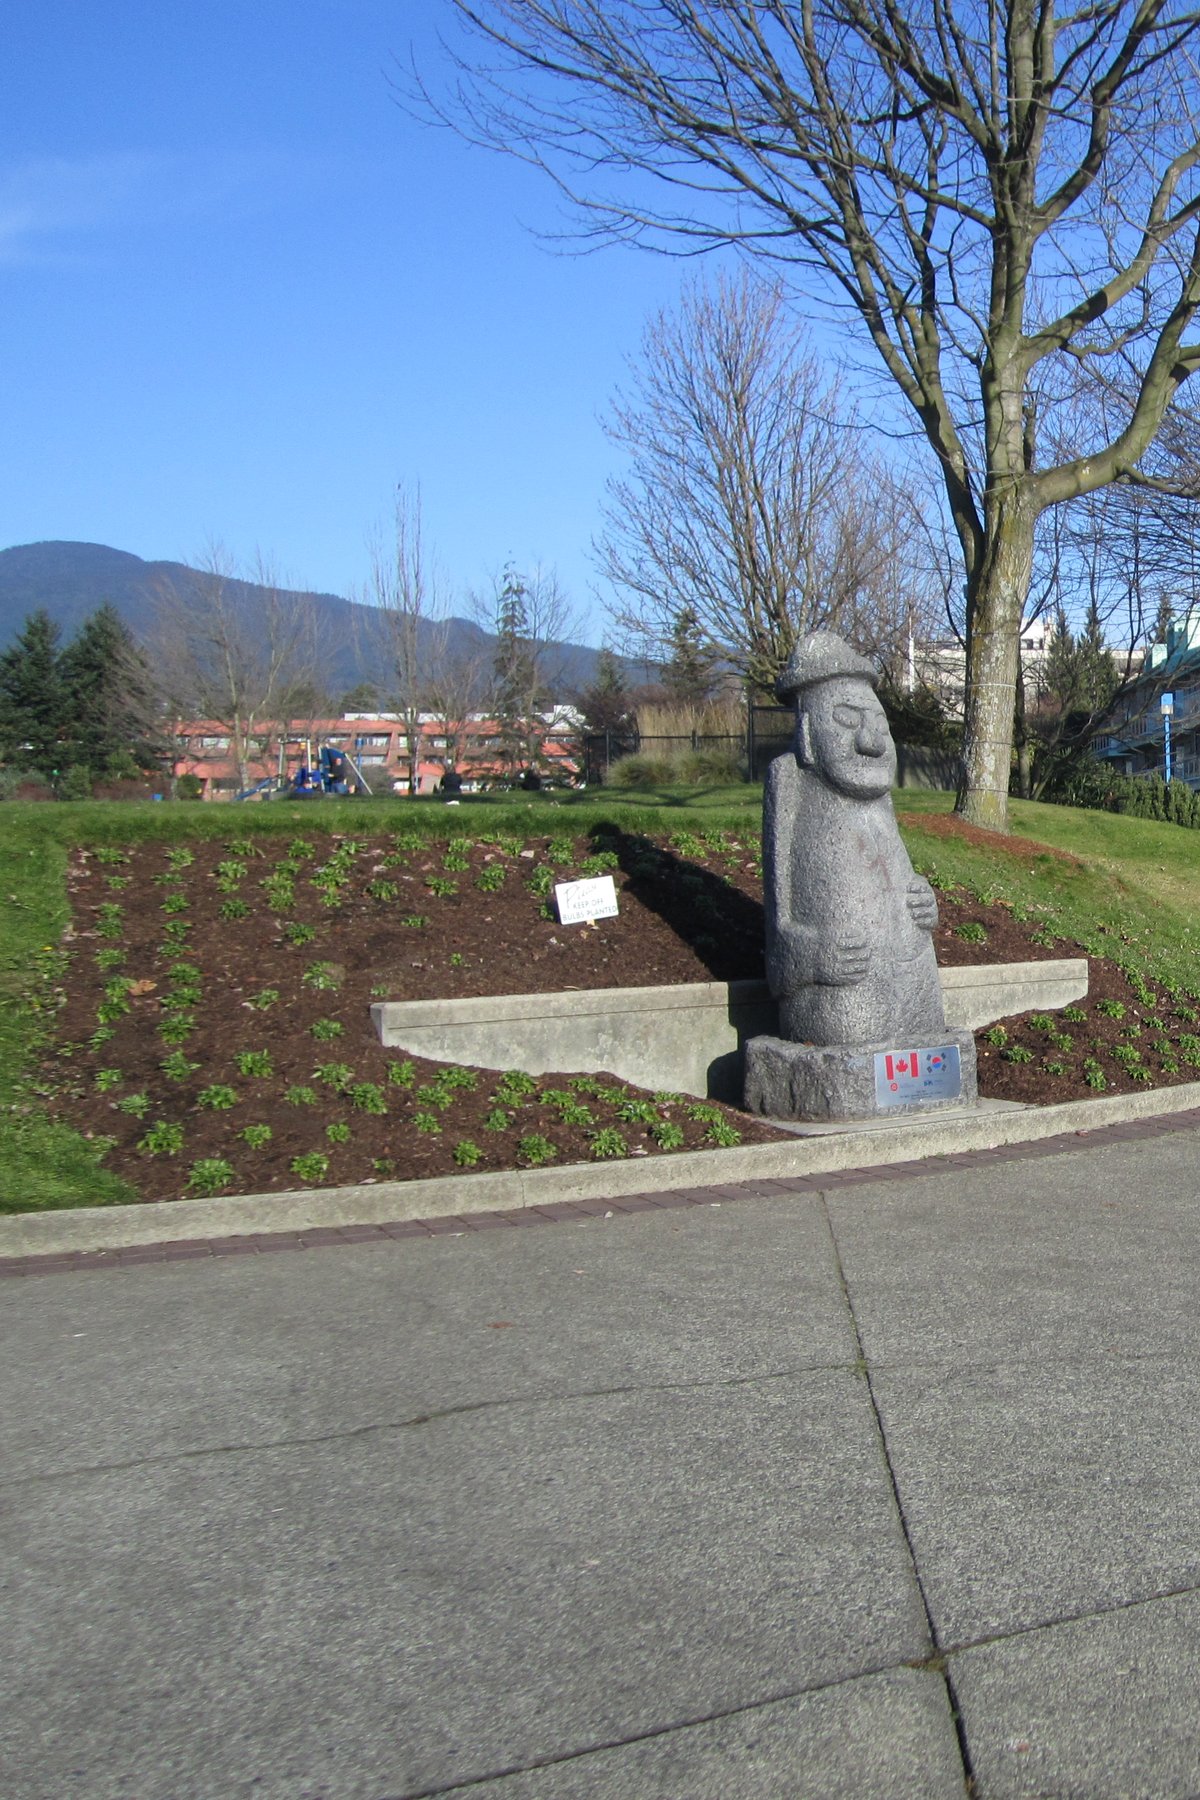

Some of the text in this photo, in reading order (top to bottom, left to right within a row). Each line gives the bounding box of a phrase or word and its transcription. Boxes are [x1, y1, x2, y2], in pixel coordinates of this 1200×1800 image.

[573, 898, 604, 909] KEEP OFF
[562, 905, 617, 921] BULBS PLANTED
